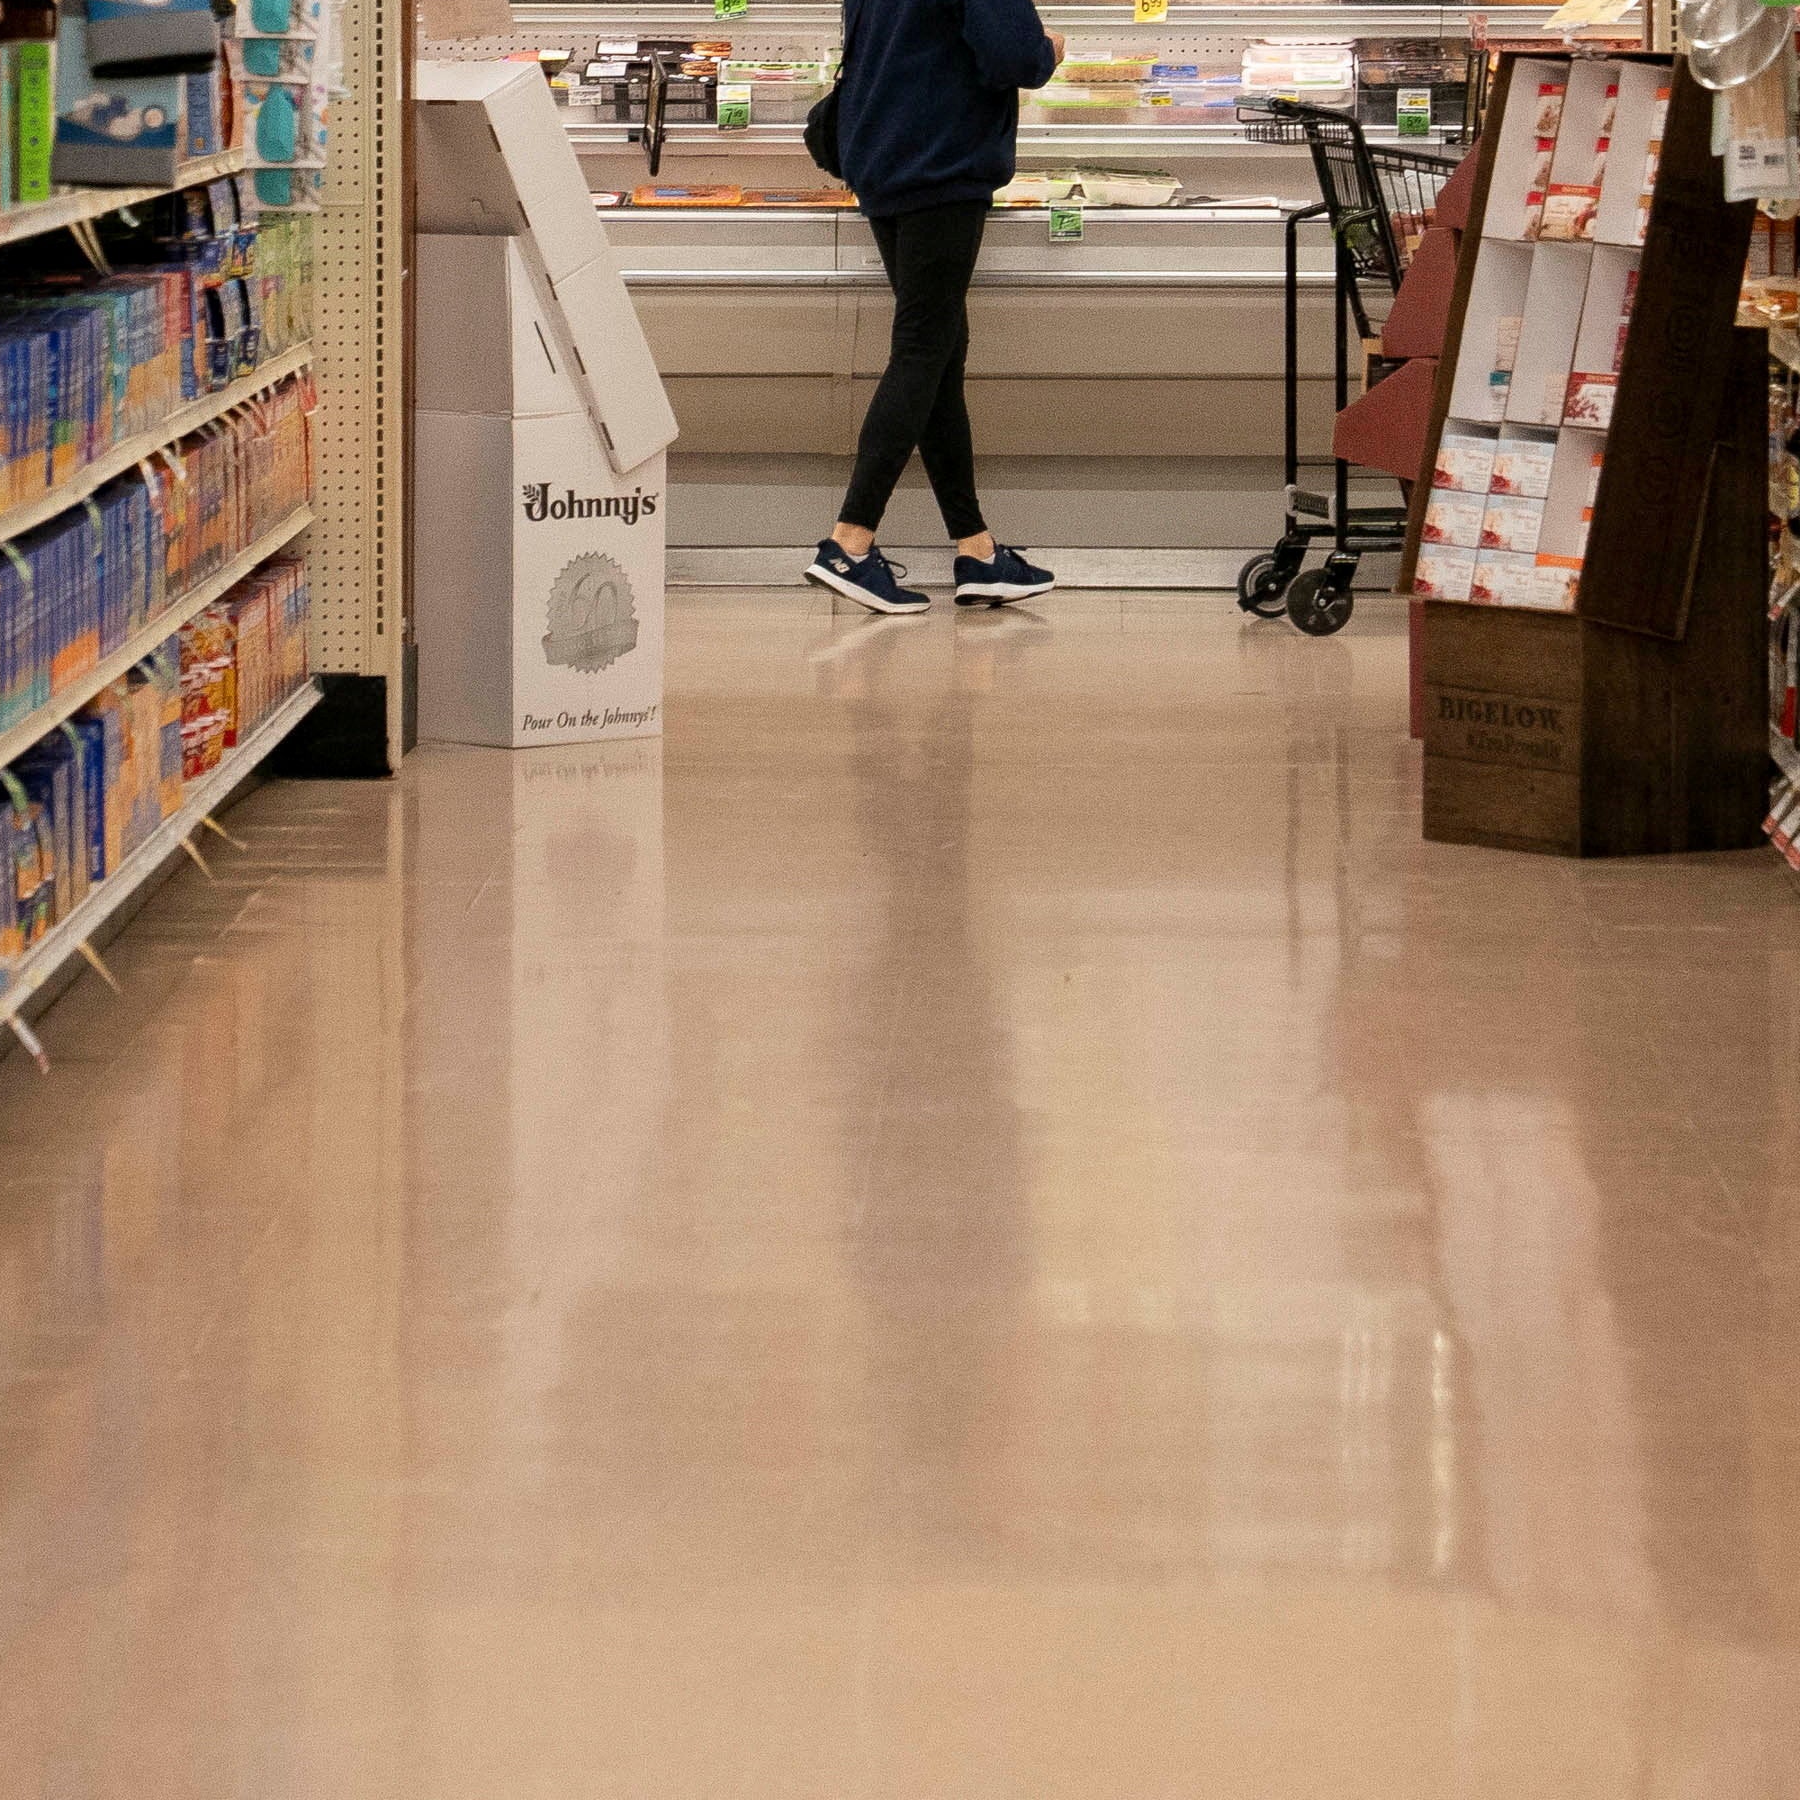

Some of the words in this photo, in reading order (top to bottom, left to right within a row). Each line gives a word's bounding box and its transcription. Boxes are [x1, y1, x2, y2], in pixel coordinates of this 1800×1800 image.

[522, 482, 657, 526] Johnny's
[522, 714, 554, 731] Pour
[556, 711, 576, 729] On
[580, 709, 600, 727] the
[1438, 696, 1563, 732] BIGELOW
